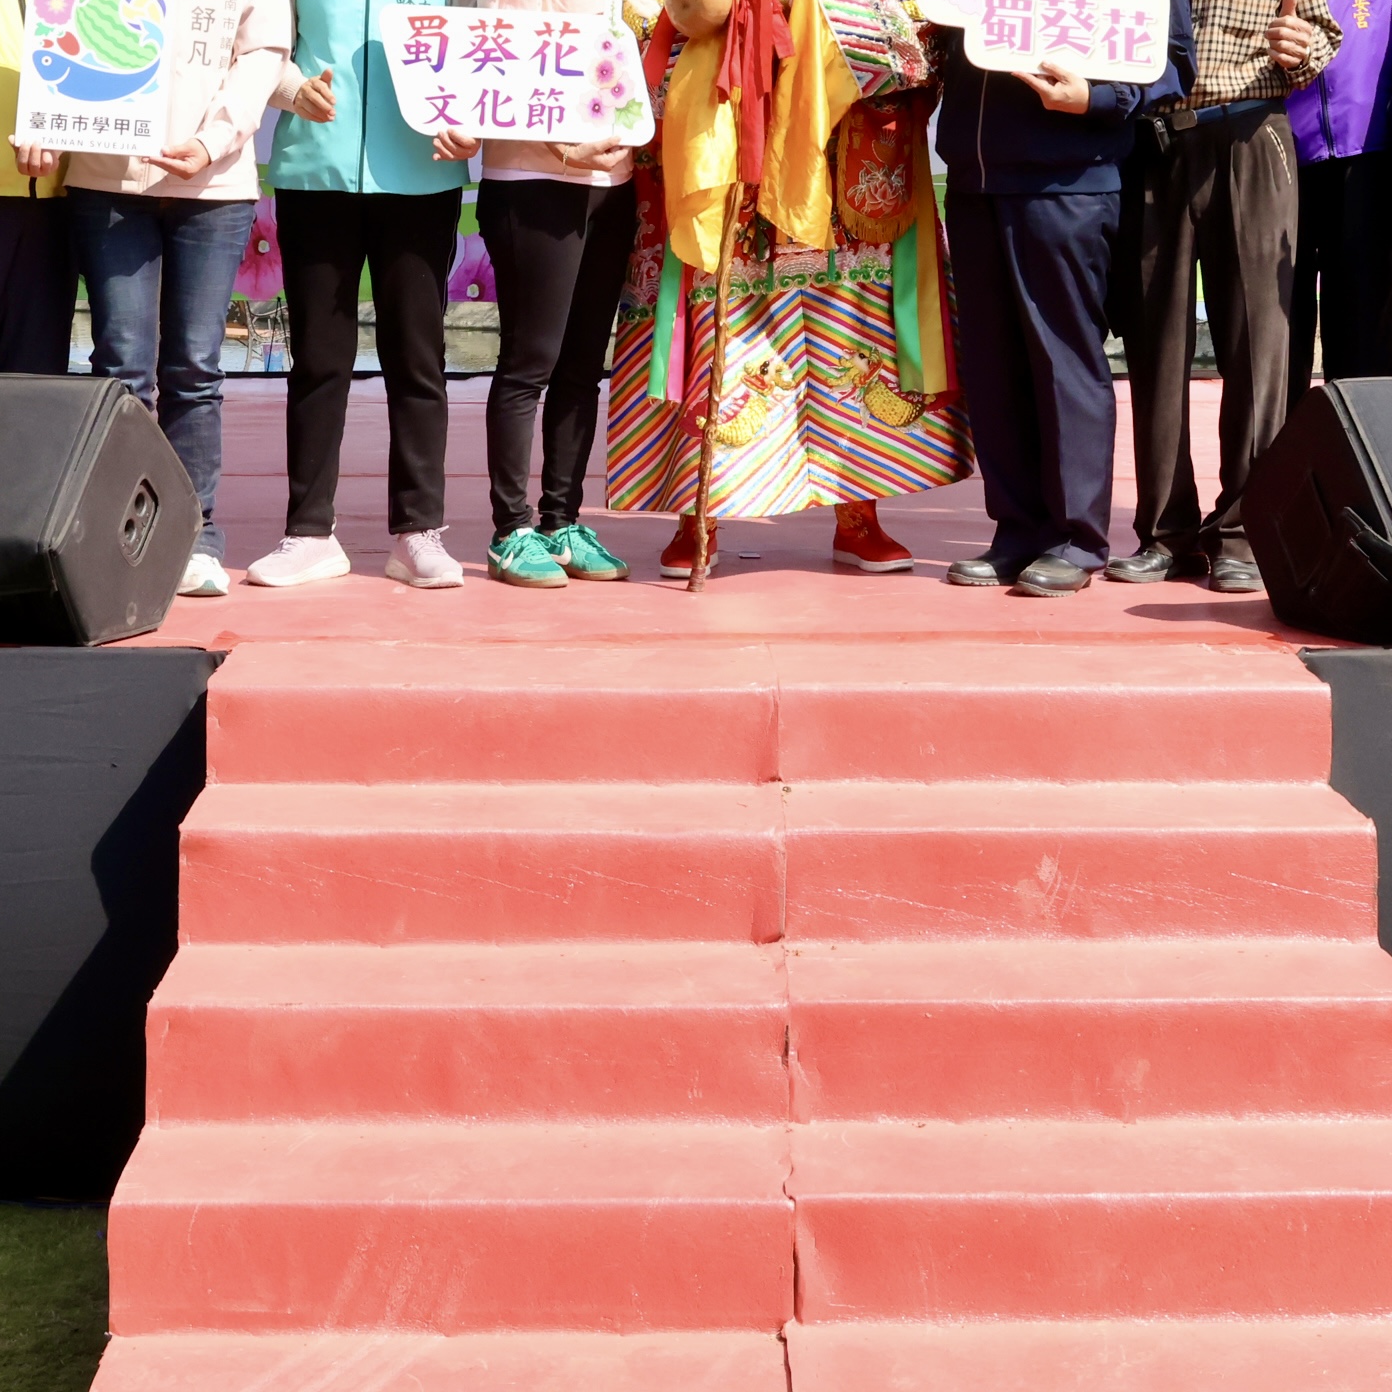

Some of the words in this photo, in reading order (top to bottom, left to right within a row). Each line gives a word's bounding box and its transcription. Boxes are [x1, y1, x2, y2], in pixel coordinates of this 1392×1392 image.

[401, 15, 584, 77] 蜀葵花
[29, 111, 152, 137] 臺南市學甲區
[423, 85, 565, 134] 文化節
[42, 136, 84, 147] TAINAN
[89, 140, 137, 151] SYUEJIA
